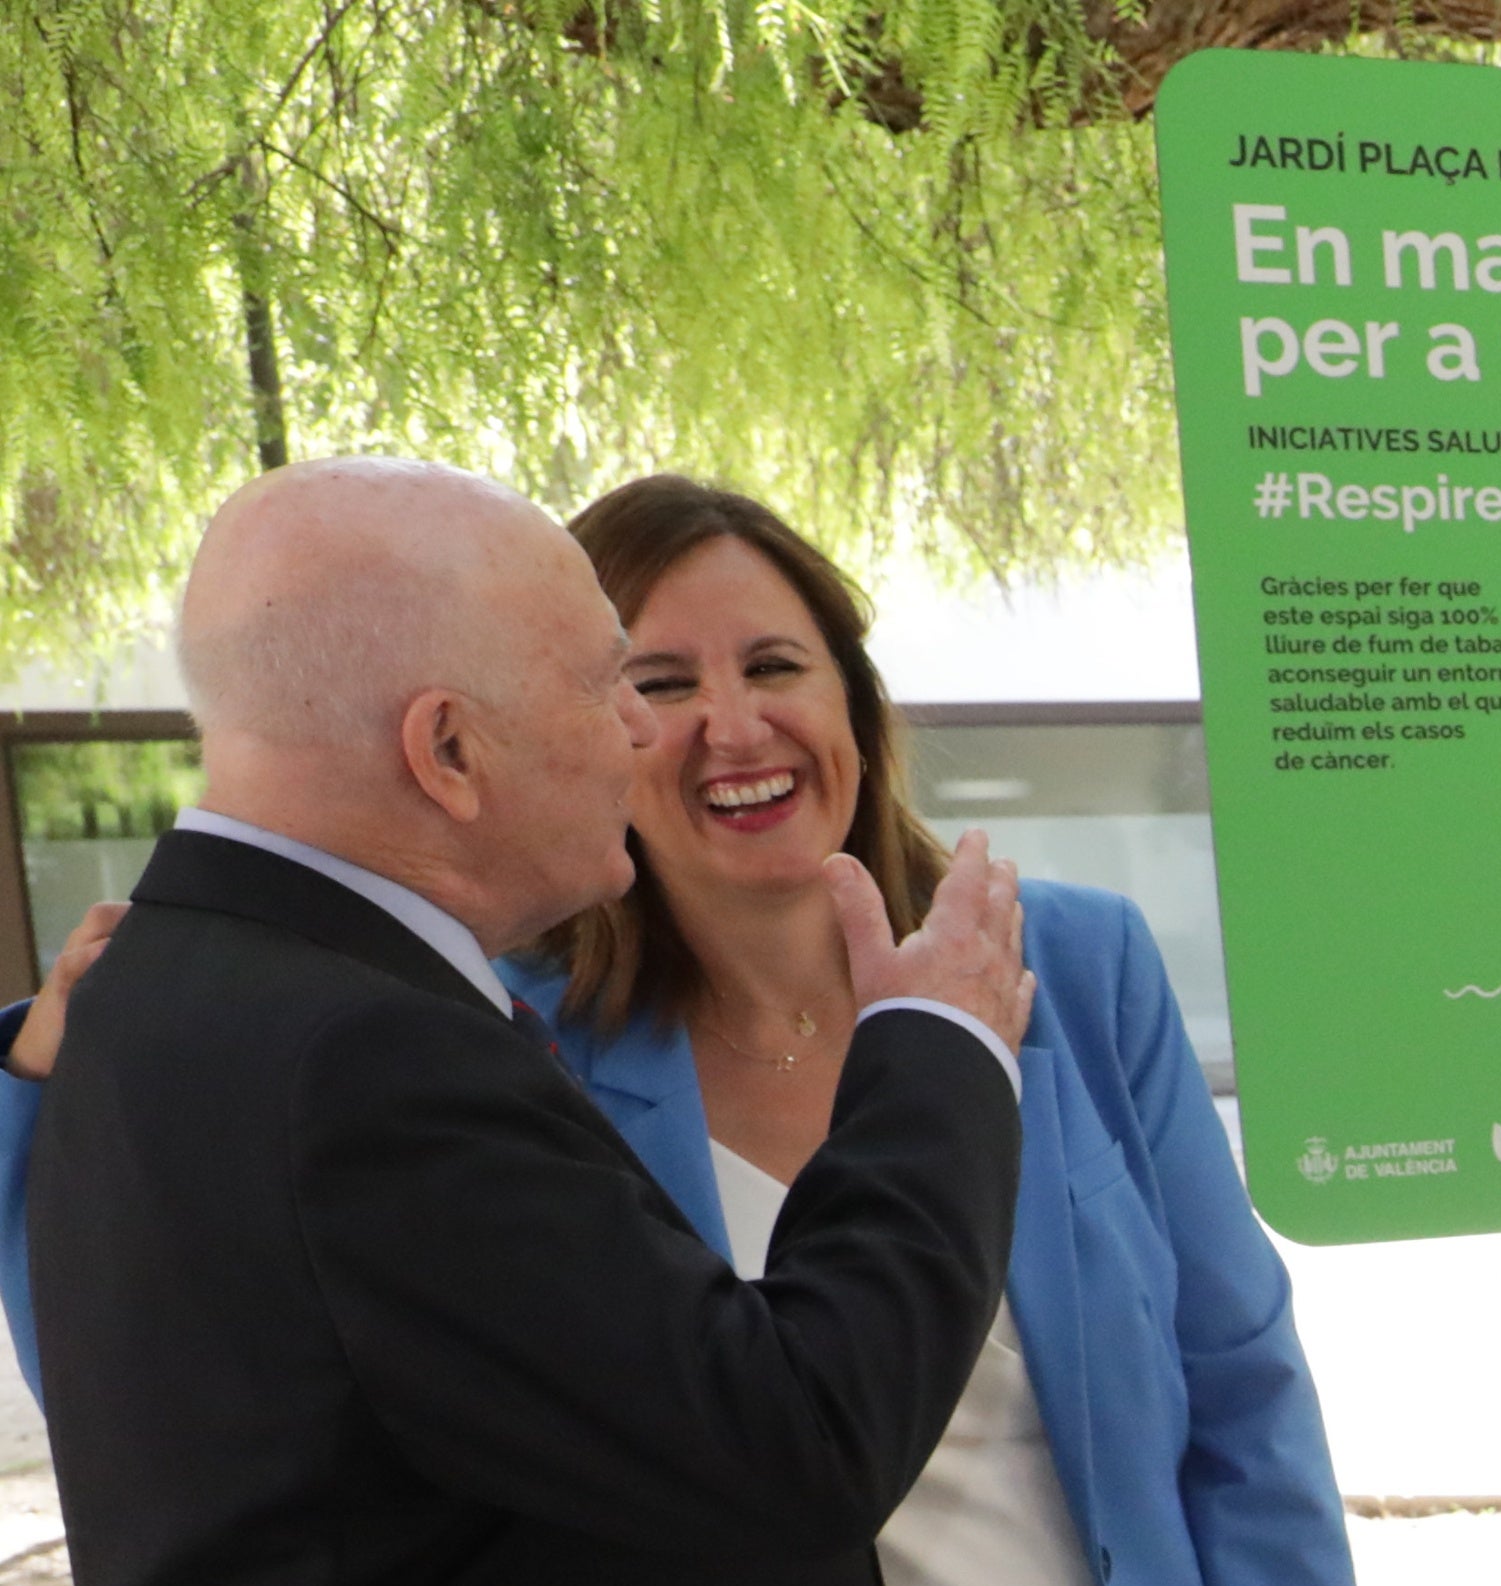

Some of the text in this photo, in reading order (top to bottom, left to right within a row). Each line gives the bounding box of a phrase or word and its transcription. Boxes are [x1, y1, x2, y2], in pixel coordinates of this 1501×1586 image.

[1228, 131, 1346, 172] JARDÍ
[1358, 141, 1489, 186] PLAÇA
[1232, 202, 1352, 286] En
[1239, 316, 1400, 398] per
[1426, 323, 1481, 382] a
[1248, 425, 1420, 453] INICIATIVES
[1260, 576, 1481, 601] Gràcies per fer que
[1263, 606, 1499, 630] este espai siga 100%
[1265, 635, 1326, 654] lliure
[1332, 636, 1361, 653] de
[1368, 634, 1413, 653] fum
[1420, 635, 1448, 653] de
[1268, 664, 1396, 688] aconseguir
[1403, 668, 1431, 682] un
[1270, 693, 1385, 713] saludable
[1391, 692, 1442, 711] amb
[1447, 692, 1470, 711] el
[1361, 722, 1395, 740] els
[1400, 725, 1465, 740] casos
[1274, 751, 1305, 771] de
[1345, 1138, 1456, 1161] AJUNTAMENT
[1345, 1164, 1369, 1180] DE
